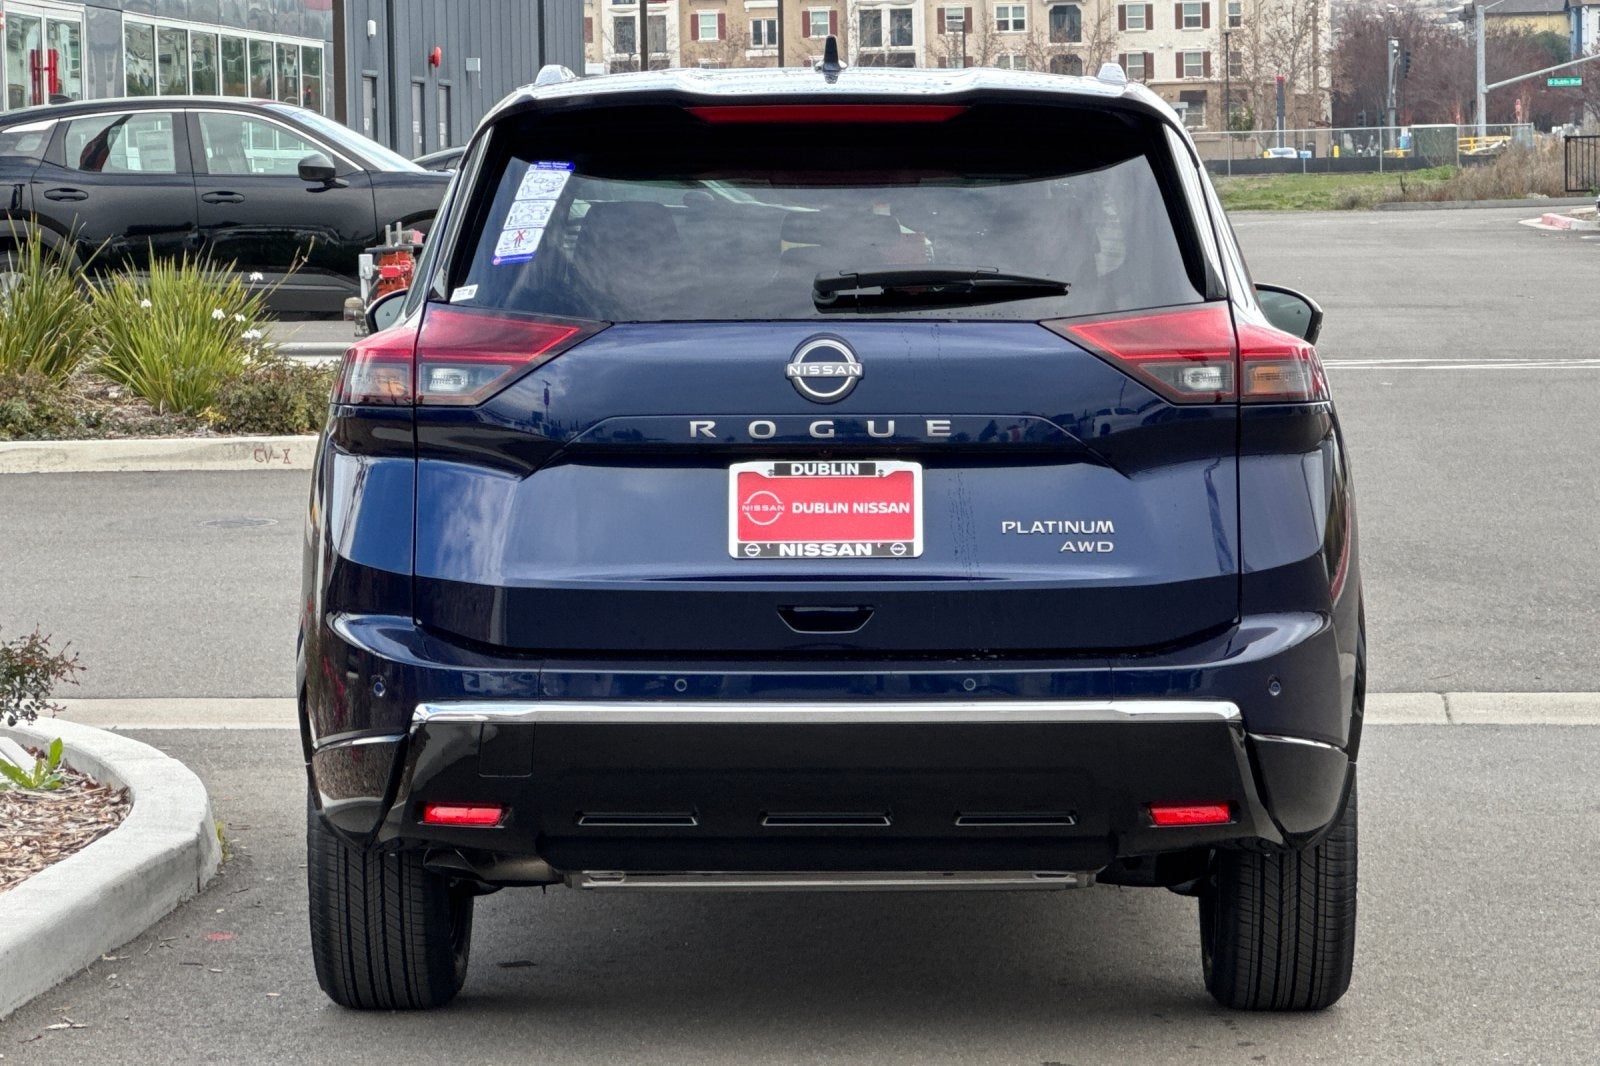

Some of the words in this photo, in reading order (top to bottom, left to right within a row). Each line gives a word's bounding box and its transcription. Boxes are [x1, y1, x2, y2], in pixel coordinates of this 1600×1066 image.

[788, 365, 862, 375] NISSAN
[689, 420, 952, 439] ROGUE
[790, 463, 859, 475] DUBLIN
[742, 504, 785, 512] NISSAN
[792, 502, 848, 514] DUBLIN
[852, 502, 910, 514] NISSAN
[1001, 520, 1115, 534] PLATINUM
[779, 543, 872, 556] NISSAN
[1060, 541, 1114, 553] AWD
